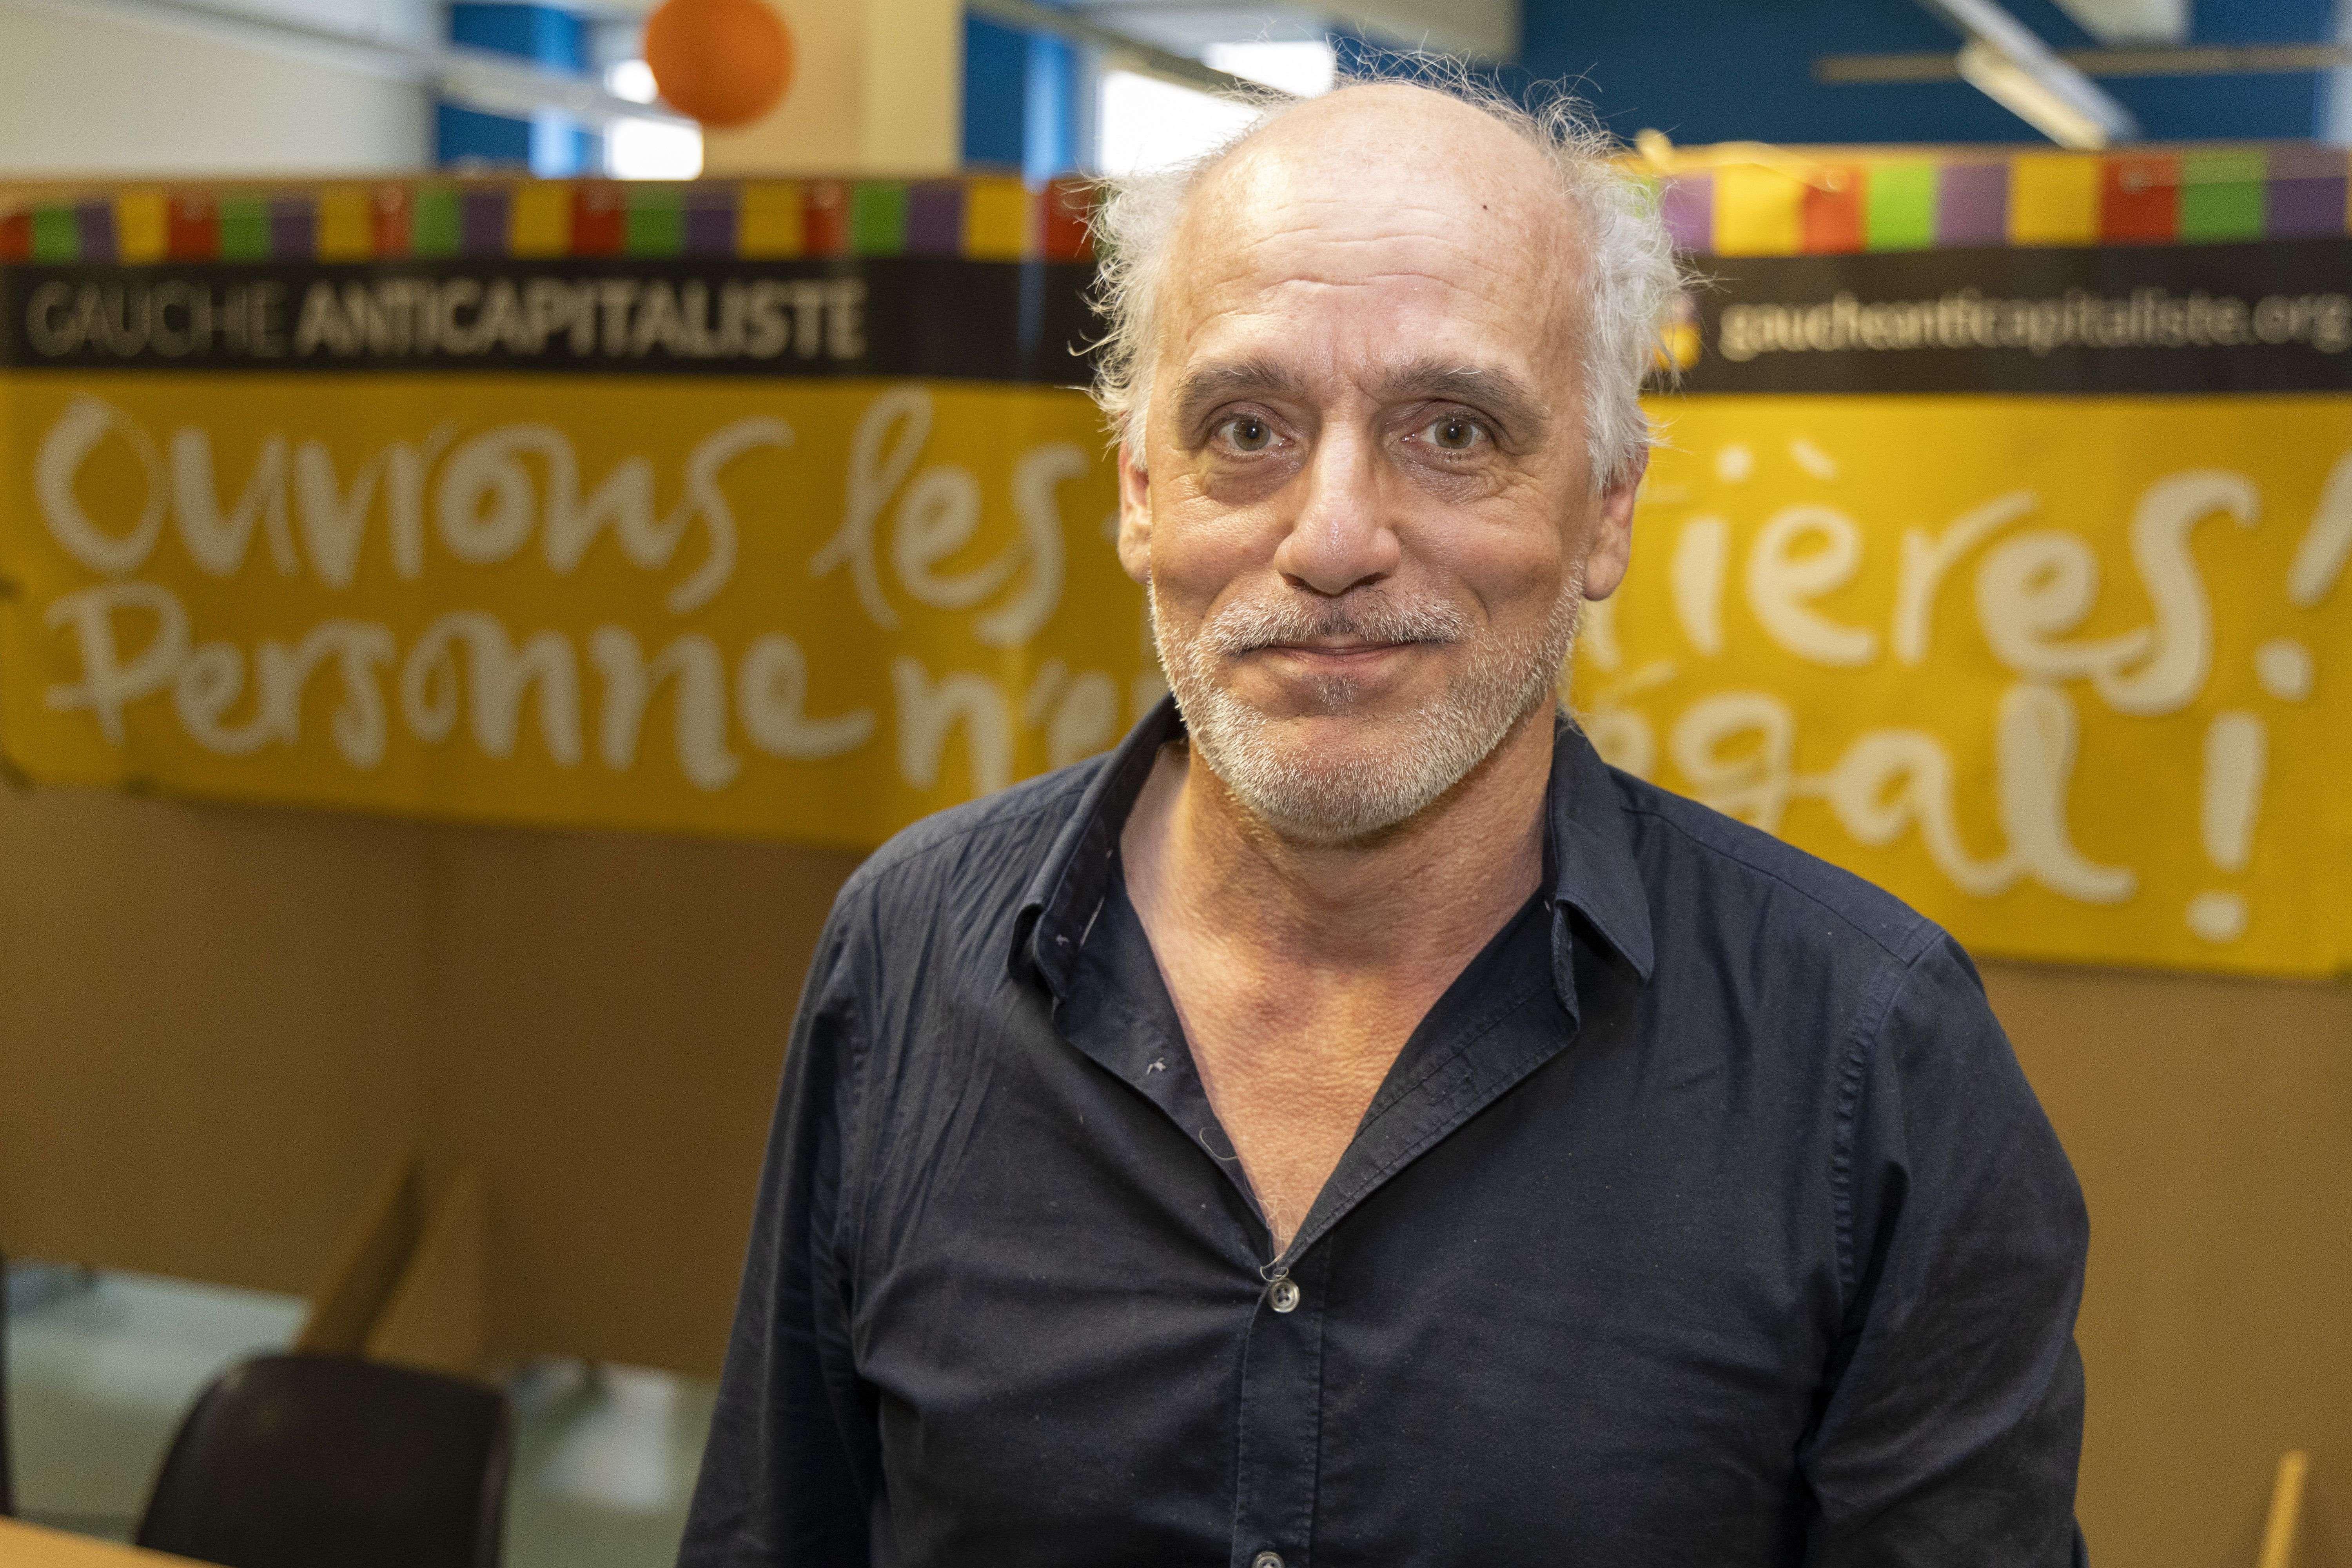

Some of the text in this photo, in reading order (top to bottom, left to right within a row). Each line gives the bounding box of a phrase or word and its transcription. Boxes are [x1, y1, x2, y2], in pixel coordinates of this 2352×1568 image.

[26, 277, 866, 358] GAUCHE ANTICAPITALISTE
[1719, 289, 2352, 356] gaucheanticapitaliste.org
[33, 394, 793, 613] Ouvrons
[808, 387, 1091, 645] les
[43, 582, 877, 791] Personne
